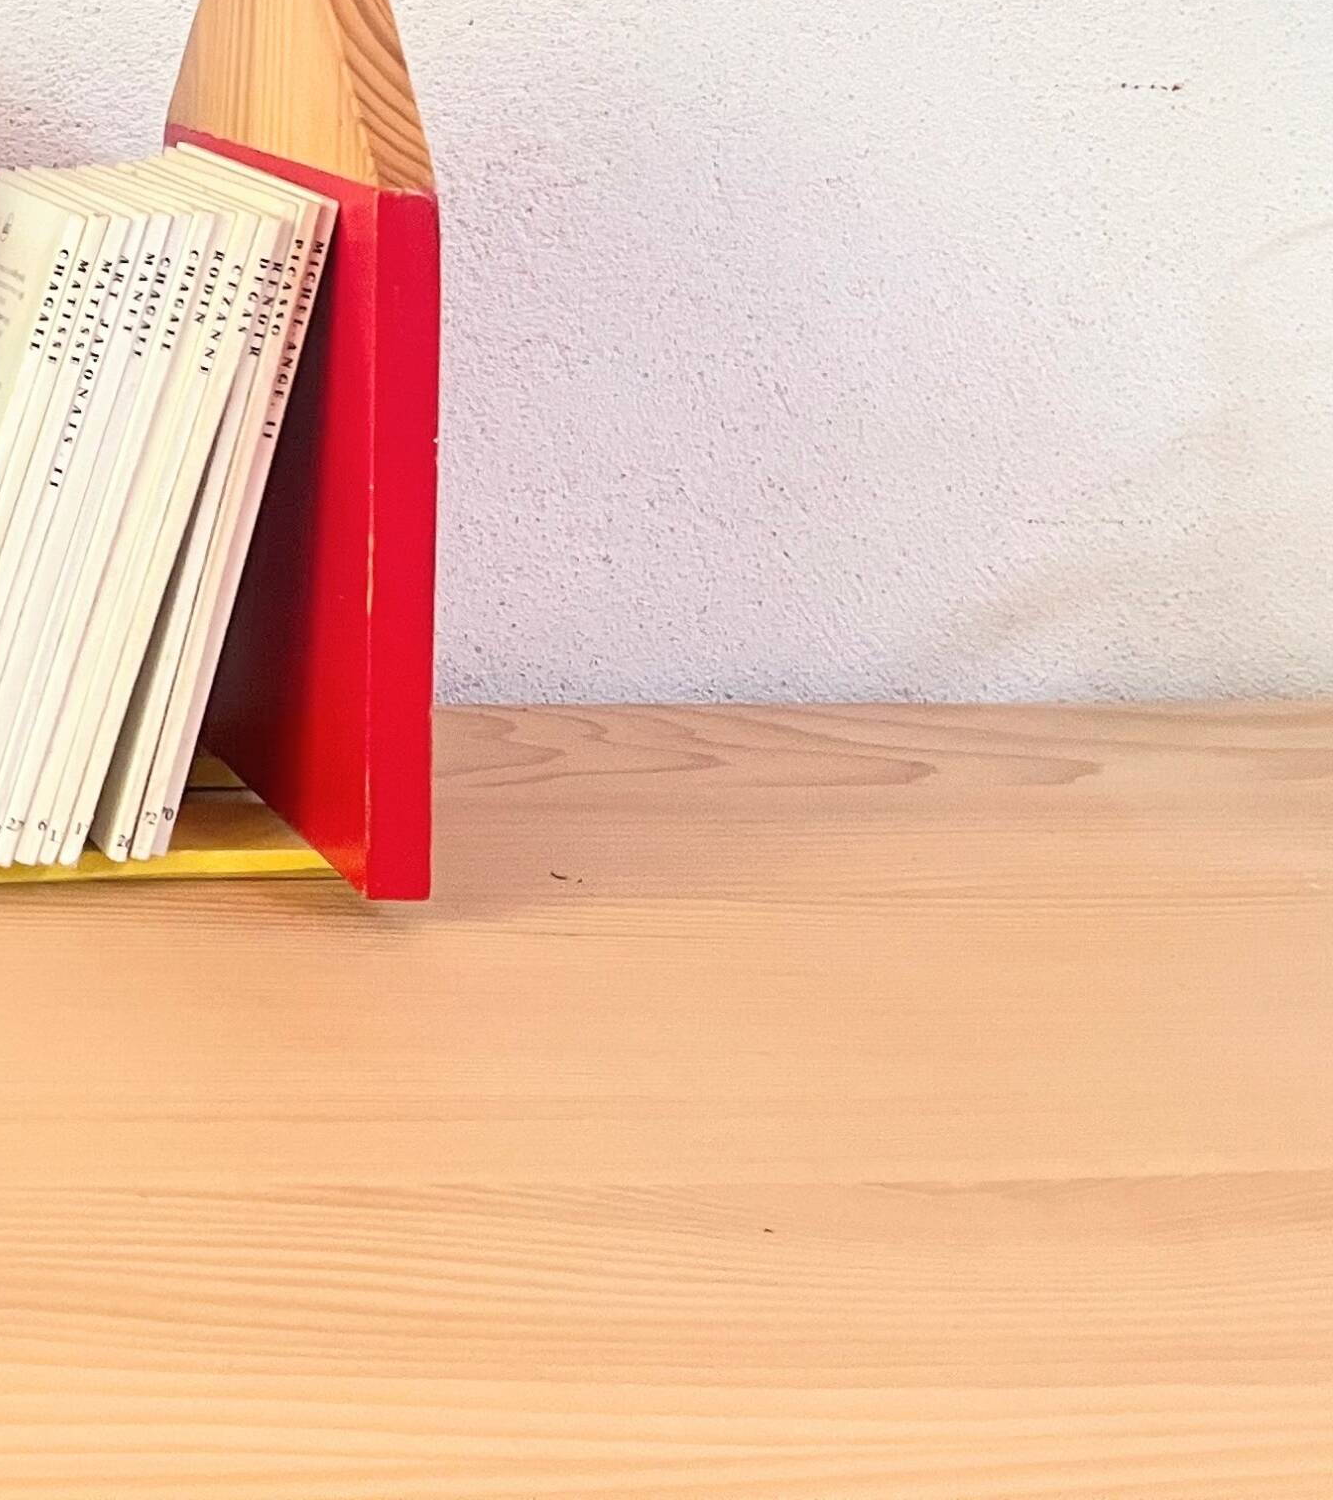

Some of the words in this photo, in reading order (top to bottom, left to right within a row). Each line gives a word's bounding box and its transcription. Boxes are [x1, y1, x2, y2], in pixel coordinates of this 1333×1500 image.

[30, 249, 69, 351] CHAGALL
[47, 259, 90, 364] MATISSE
[70, 259, 113, 365] MATISSE
[108, 255, 130, 299] ART
[133, 257, 172, 358] CHAGALL
[161, 250, 199, 351] CHAGALL
[195, 250, 226, 325] RODIN
[271, 238, 304, 336] PICASSO
[63, 318, 110, 444] JAPONAIS
